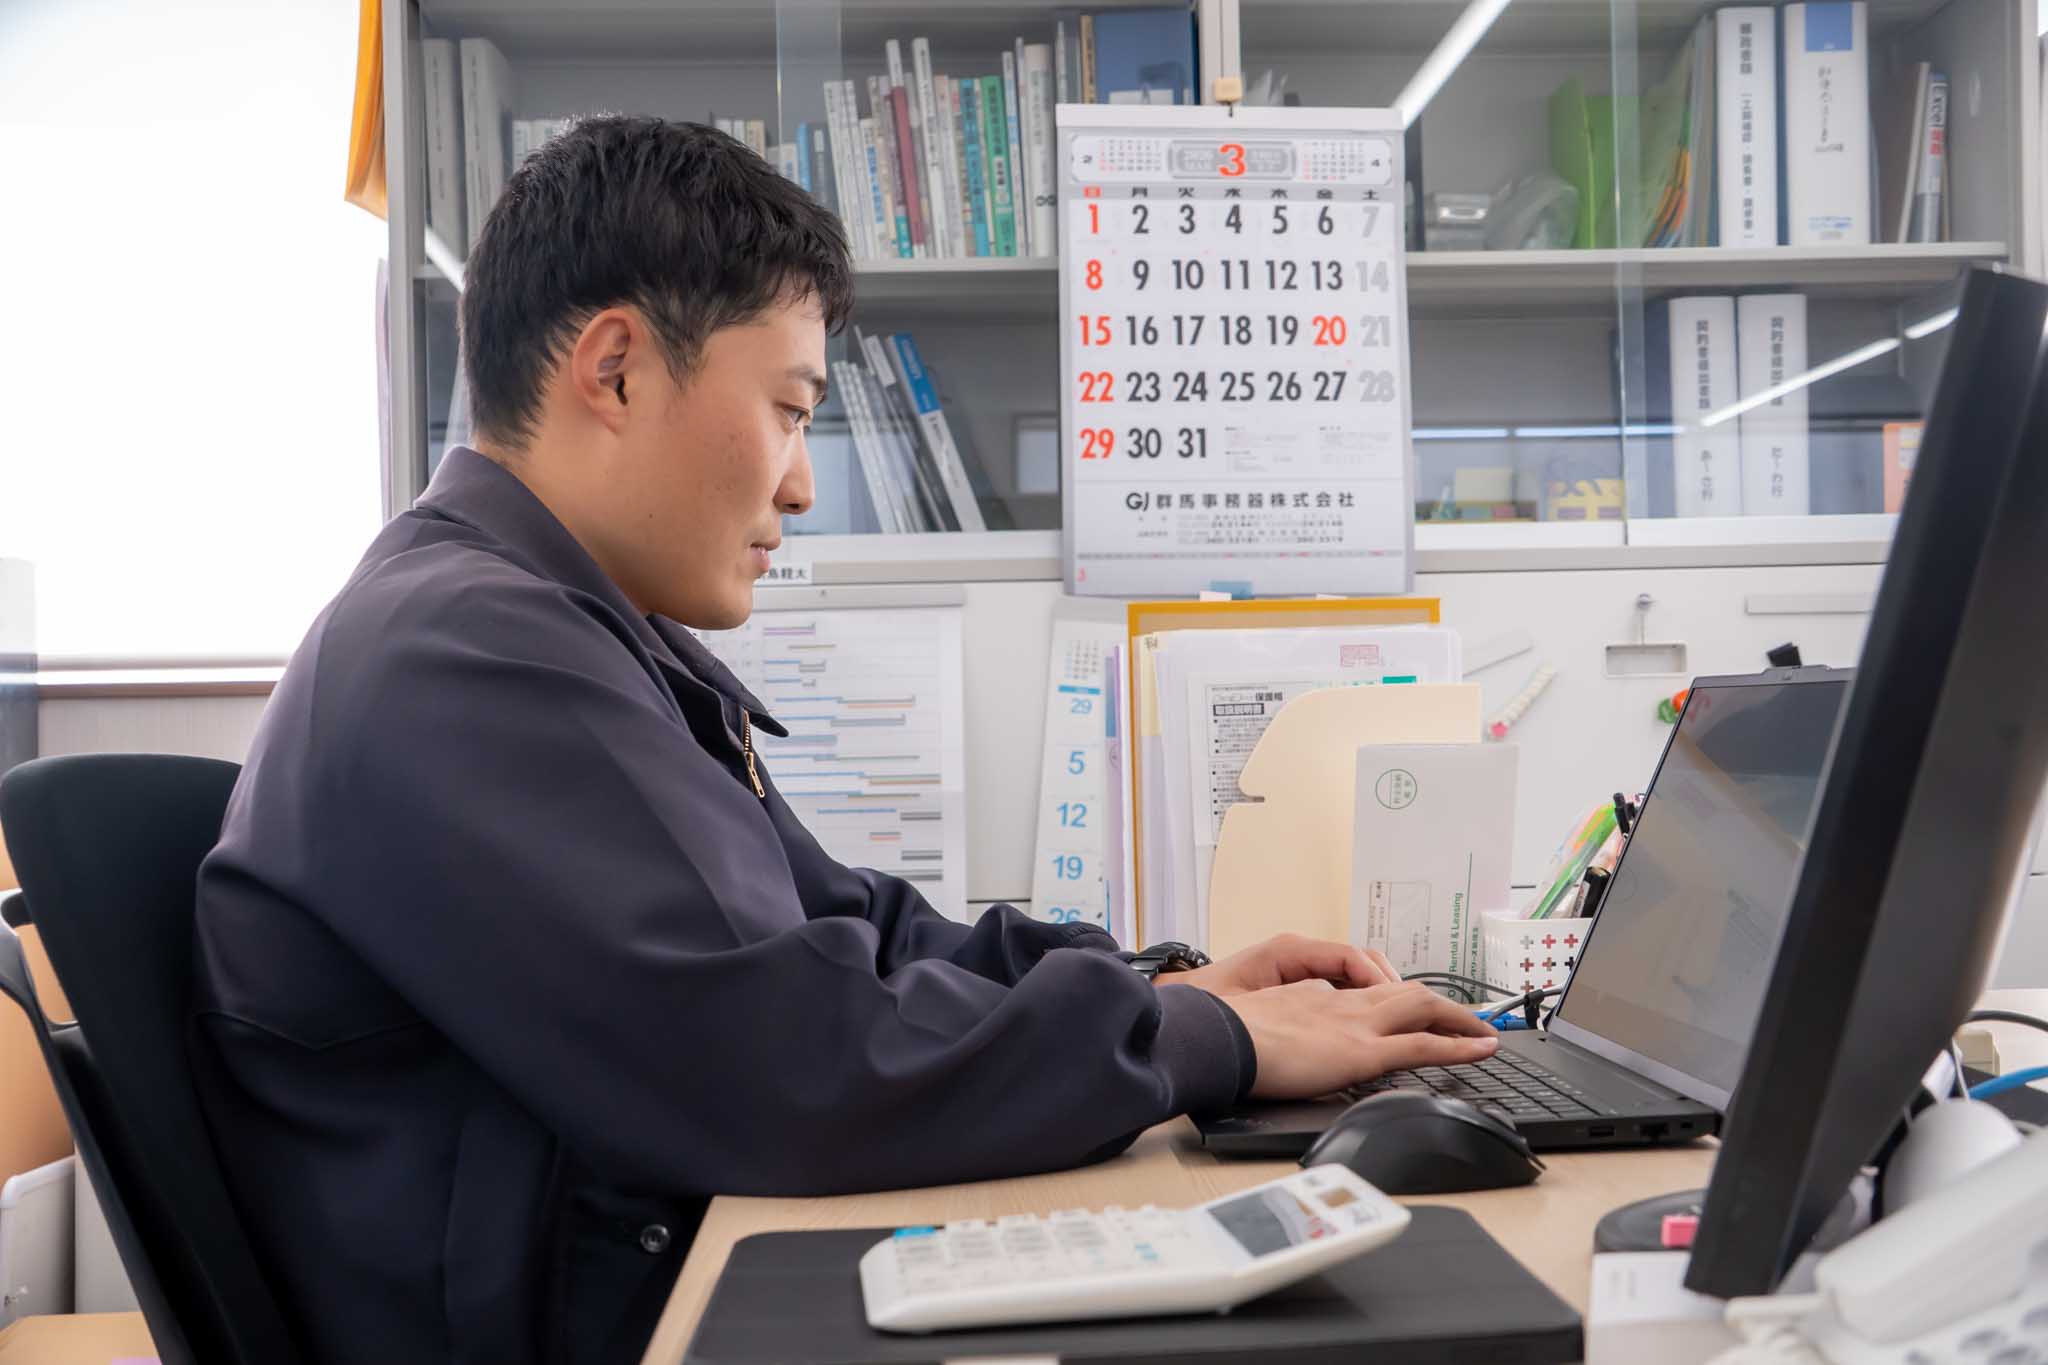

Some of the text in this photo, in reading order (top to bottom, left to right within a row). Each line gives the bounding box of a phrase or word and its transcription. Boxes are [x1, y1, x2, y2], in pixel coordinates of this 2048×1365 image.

[1083, 155, 1093, 163] 2
[1219, 144, 1246, 177] 3
[1371, 160, 1381, 168] 4
[1084, 186, 1378, 200] 日 月 火 水 木 金 土
[1089, 204, 1379, 237] 1 2 3 4 5 6 7
[1086, 260, 1389, 292] 8 9 10 11 12 13 14
[1080, 316, 1390, 347] 15 16 17 18 19 20 21
[1080, 370, 1394, 402] 22 23 24 25 26 27 28
[1081, 429, 1114, 458] 29
[1128, 428, 1161, 458] 30
[1178, 428, 1205, 458] 31
[1156, 492, 1355, 510] 群馬事務器株式会社
[1070, 699, 1092, 714] 29
[1068, 752, 1085, 775] 5
[1057, 803, 1087, 828] 12
[1053, 856, 1083, 880] 19
[1049, 909, 1080, 924] 26
[1451, 892, 1463, 930] Leasing
[1450, 931, 1459, 939] &
[1448, 941, 1459, 973] Rental
